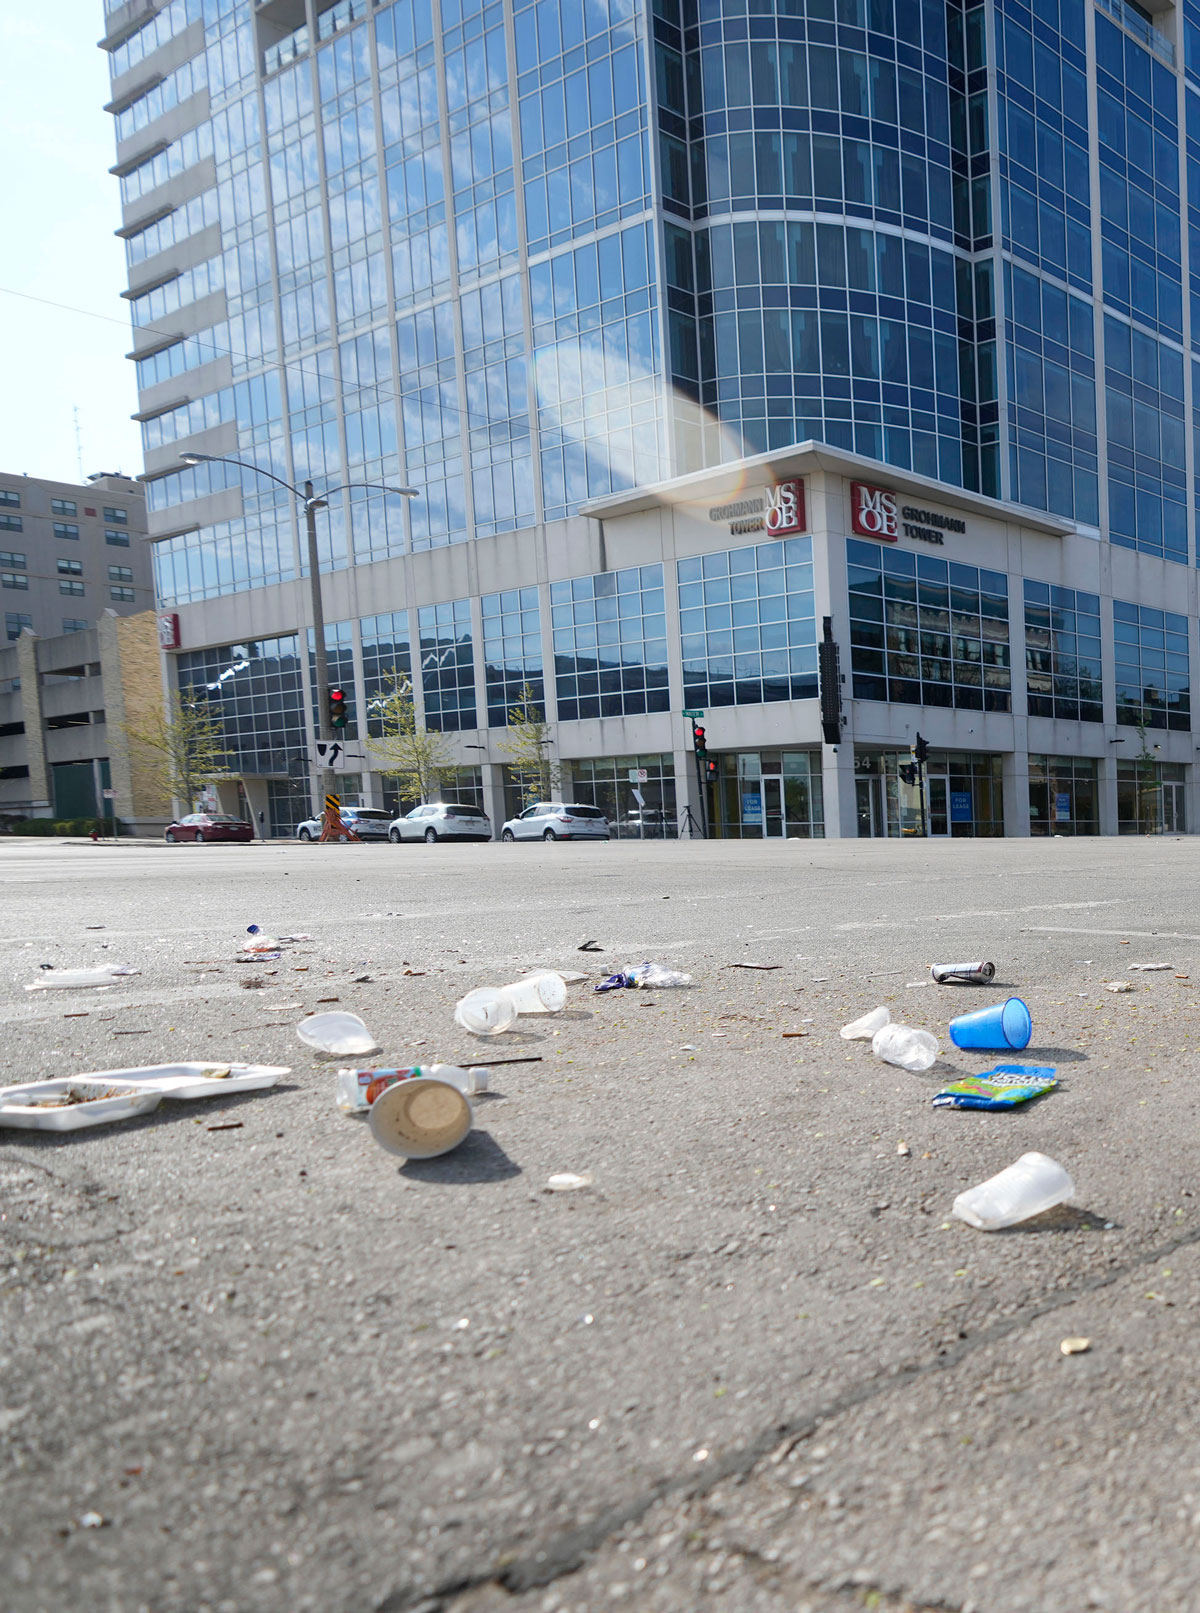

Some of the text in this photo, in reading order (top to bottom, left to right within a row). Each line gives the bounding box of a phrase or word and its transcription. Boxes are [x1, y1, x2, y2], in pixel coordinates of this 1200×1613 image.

[709, 498, 764, 521] GROHMANN
[902, 505, 966, 534] GROHMANN
[728, 516, 764, 535] TOWER
[902, 523, 944, 545] TOWER
